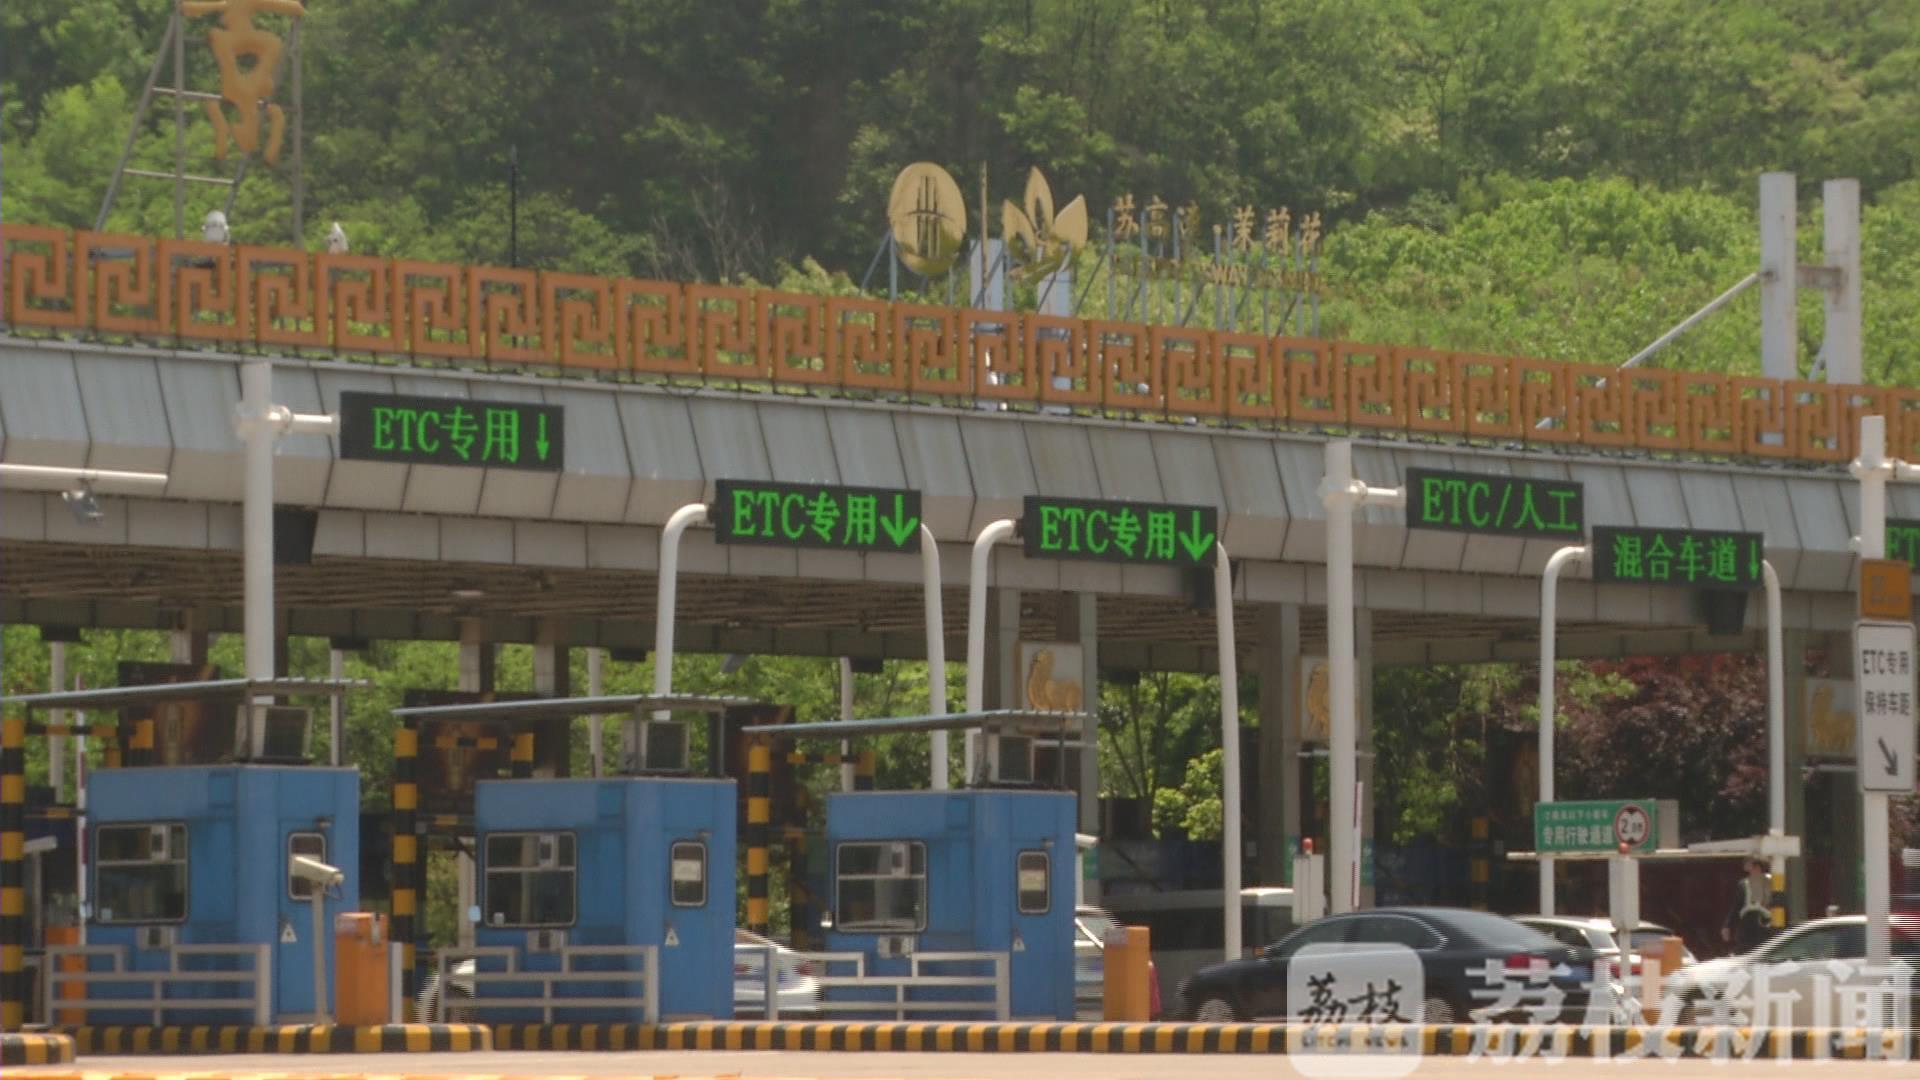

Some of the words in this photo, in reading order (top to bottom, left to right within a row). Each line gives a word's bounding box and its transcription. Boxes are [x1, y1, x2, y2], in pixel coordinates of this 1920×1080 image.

[372, 406, 519, 463] ETC专用
[731, 489, 875, 545] ETC专用
[1423, 477, 1578, 531] ETC/人工
[1039, 505, 1177, 560] ETC专用
[1613, 534, 1737, 582] 混合车道
